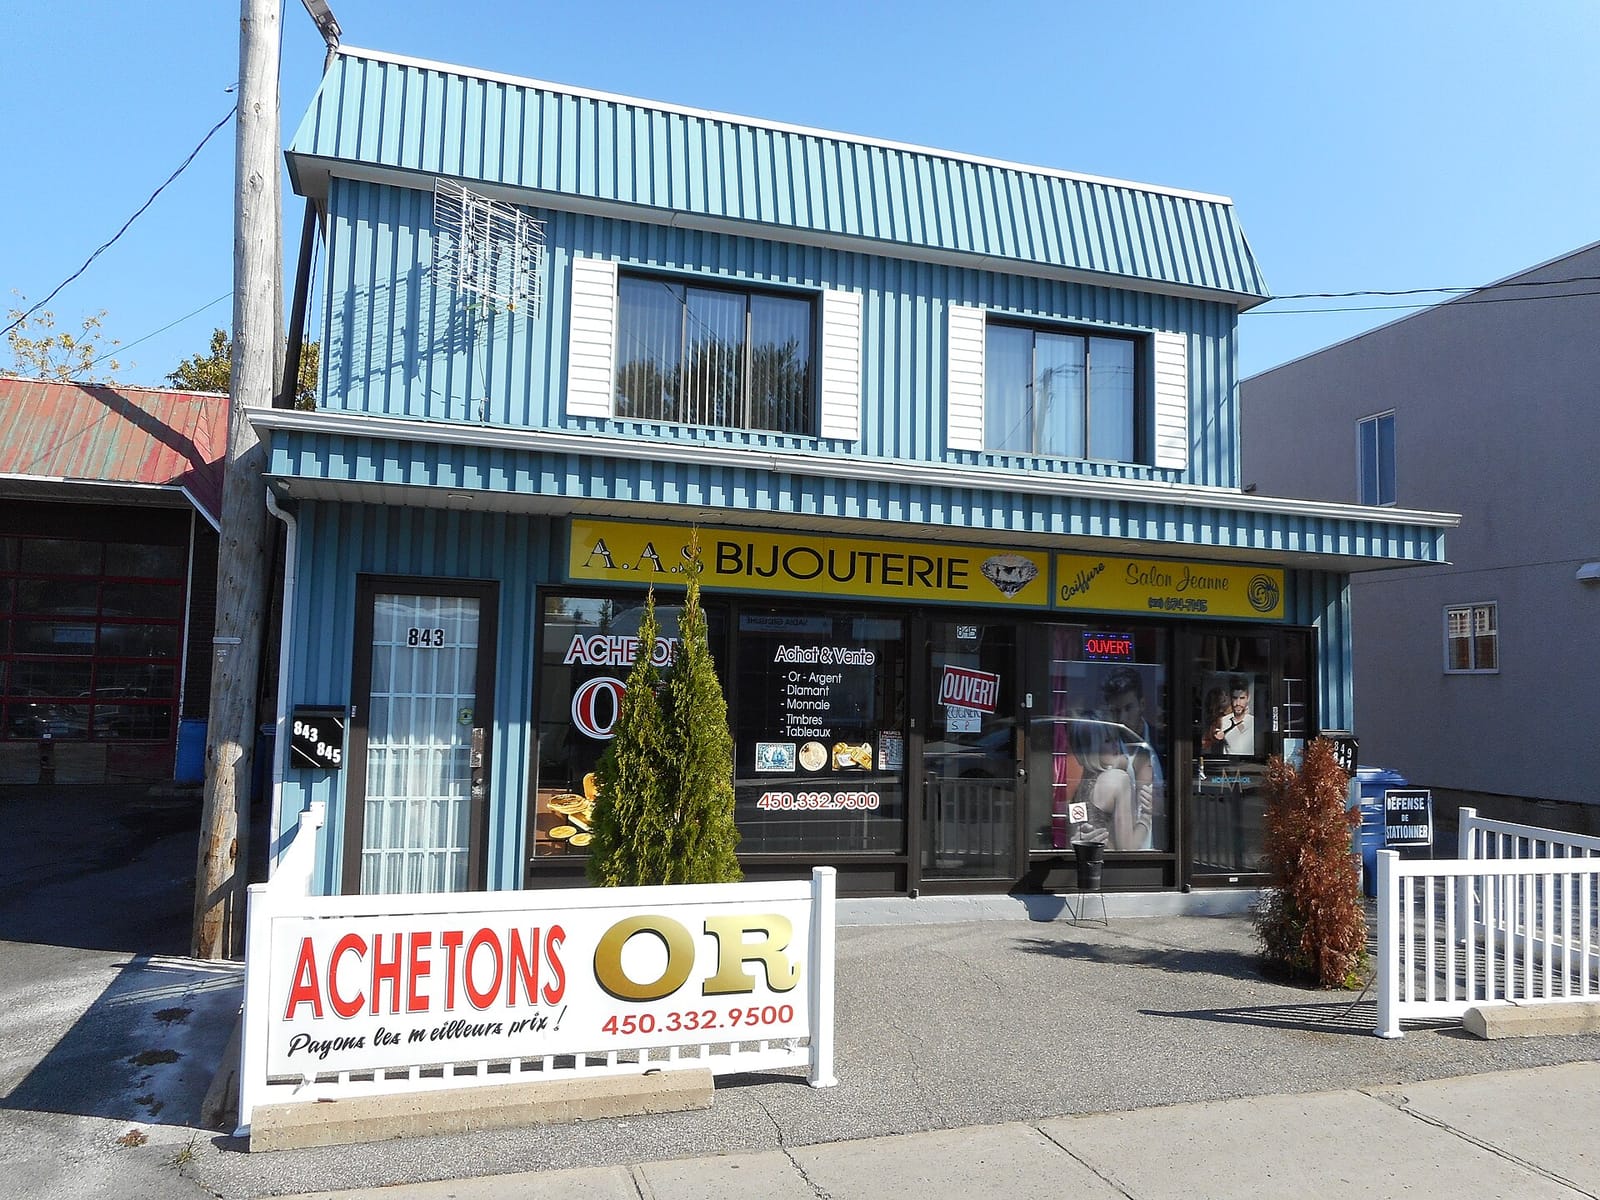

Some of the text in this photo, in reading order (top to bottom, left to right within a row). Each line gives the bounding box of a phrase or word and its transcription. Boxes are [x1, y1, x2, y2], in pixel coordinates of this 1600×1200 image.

[716, 541, 969, 590] BIJOUTERIE
[1061, 563, 1105, 601] Coiffure
[1125, 563, 1229, 592] Salon Jeanne
[408, 628, 444, 647] 843
[1087, 639, 1131, 655] OUVERT
[774, 645, 875, 666] Achat & Vente
[788, 672, 842, 686] Or Argent
[943, 672, 996, 706] OUVERT
[787, 685, 829, 696] Diamant
[787, 699, 830, 710] Monnaie
[786, 714, 823, 725] Timbres
[294, 720, 318, 743] 843
[786, 726, 831, 737] Tableaux
[317, 741, 341, 764] 845
[1334, 740, 1352, 759] 849
[757, 791, 879, 811] 450.332.9500
[1386, 825, 1429, 839] STATIONNER
[282, 913, 801, 1021] ACHETONS OR
[602, 1004, 794, 1036] 450.332.9500
[288, 1032, 366, 1059] Payons
[374, 1026, 400, 1046] les
